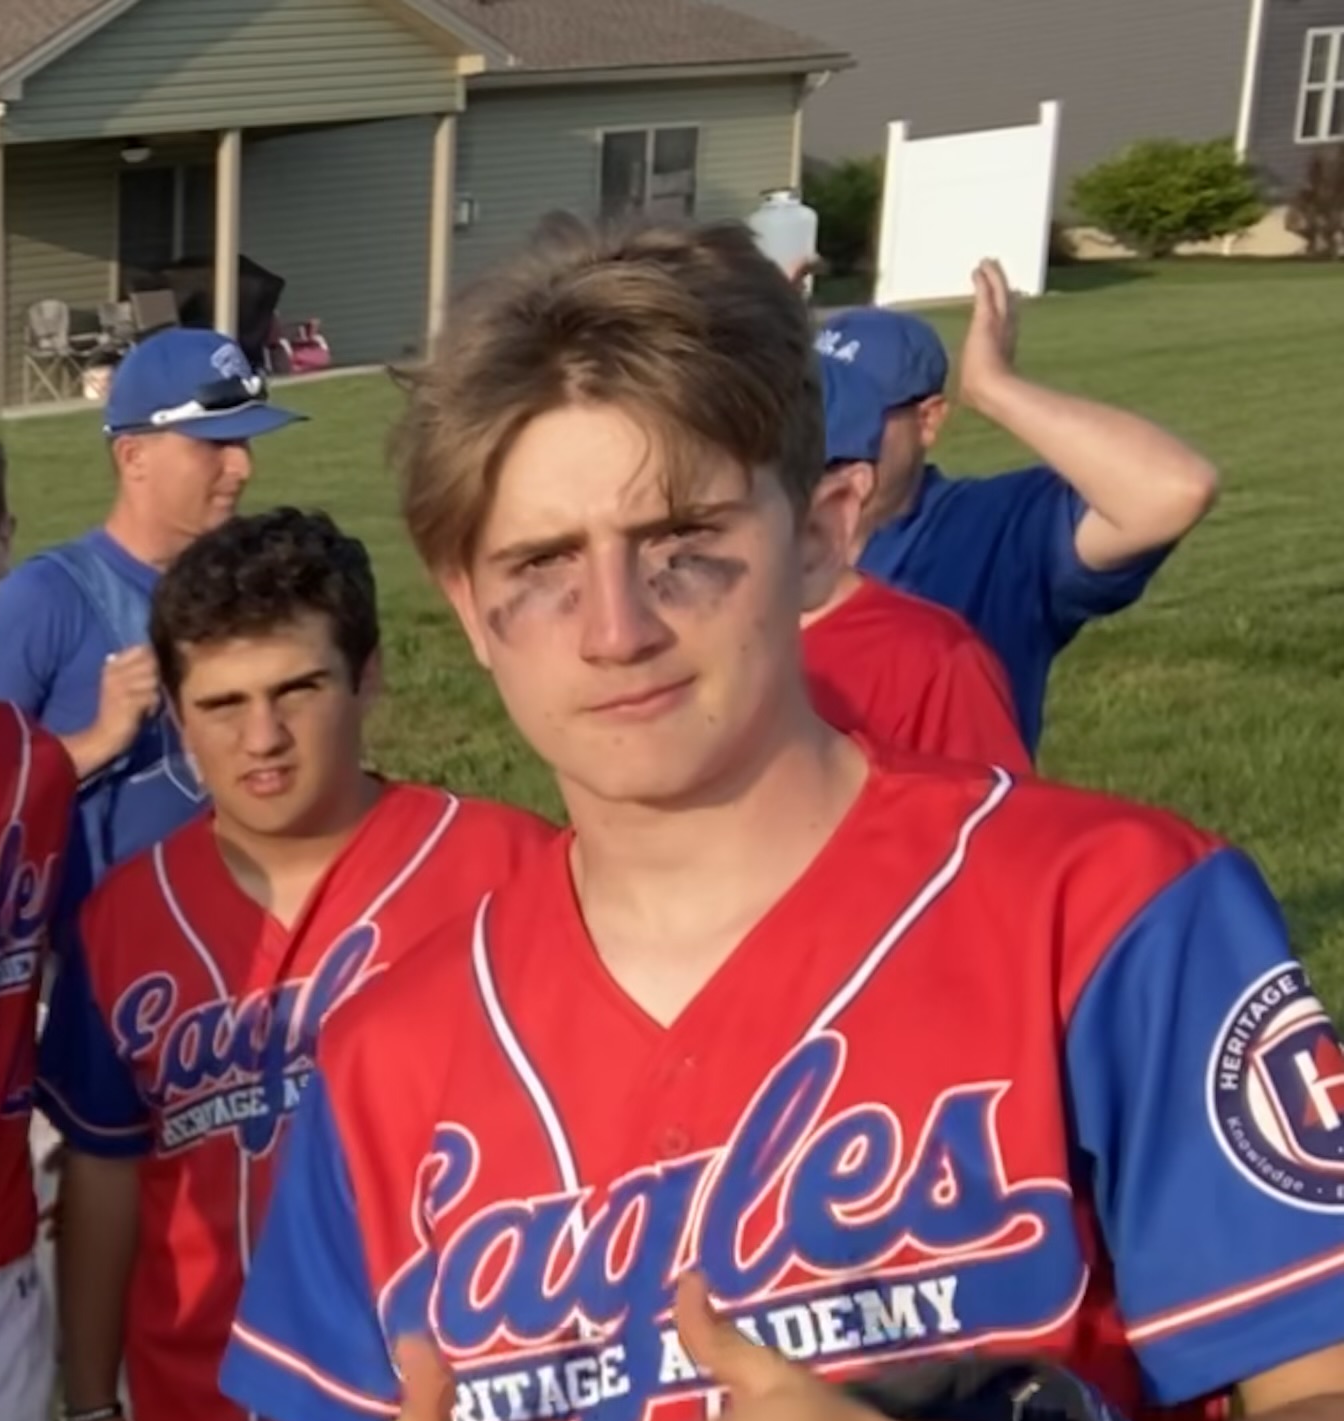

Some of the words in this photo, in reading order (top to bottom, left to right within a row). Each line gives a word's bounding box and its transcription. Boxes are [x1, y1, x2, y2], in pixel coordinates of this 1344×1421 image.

[1219, 973, 1299, 1091] HERITAGE
[1225, 1115, 1305, 1194] Knowledge
[659, 1275, 962, 1385] ADEMY
